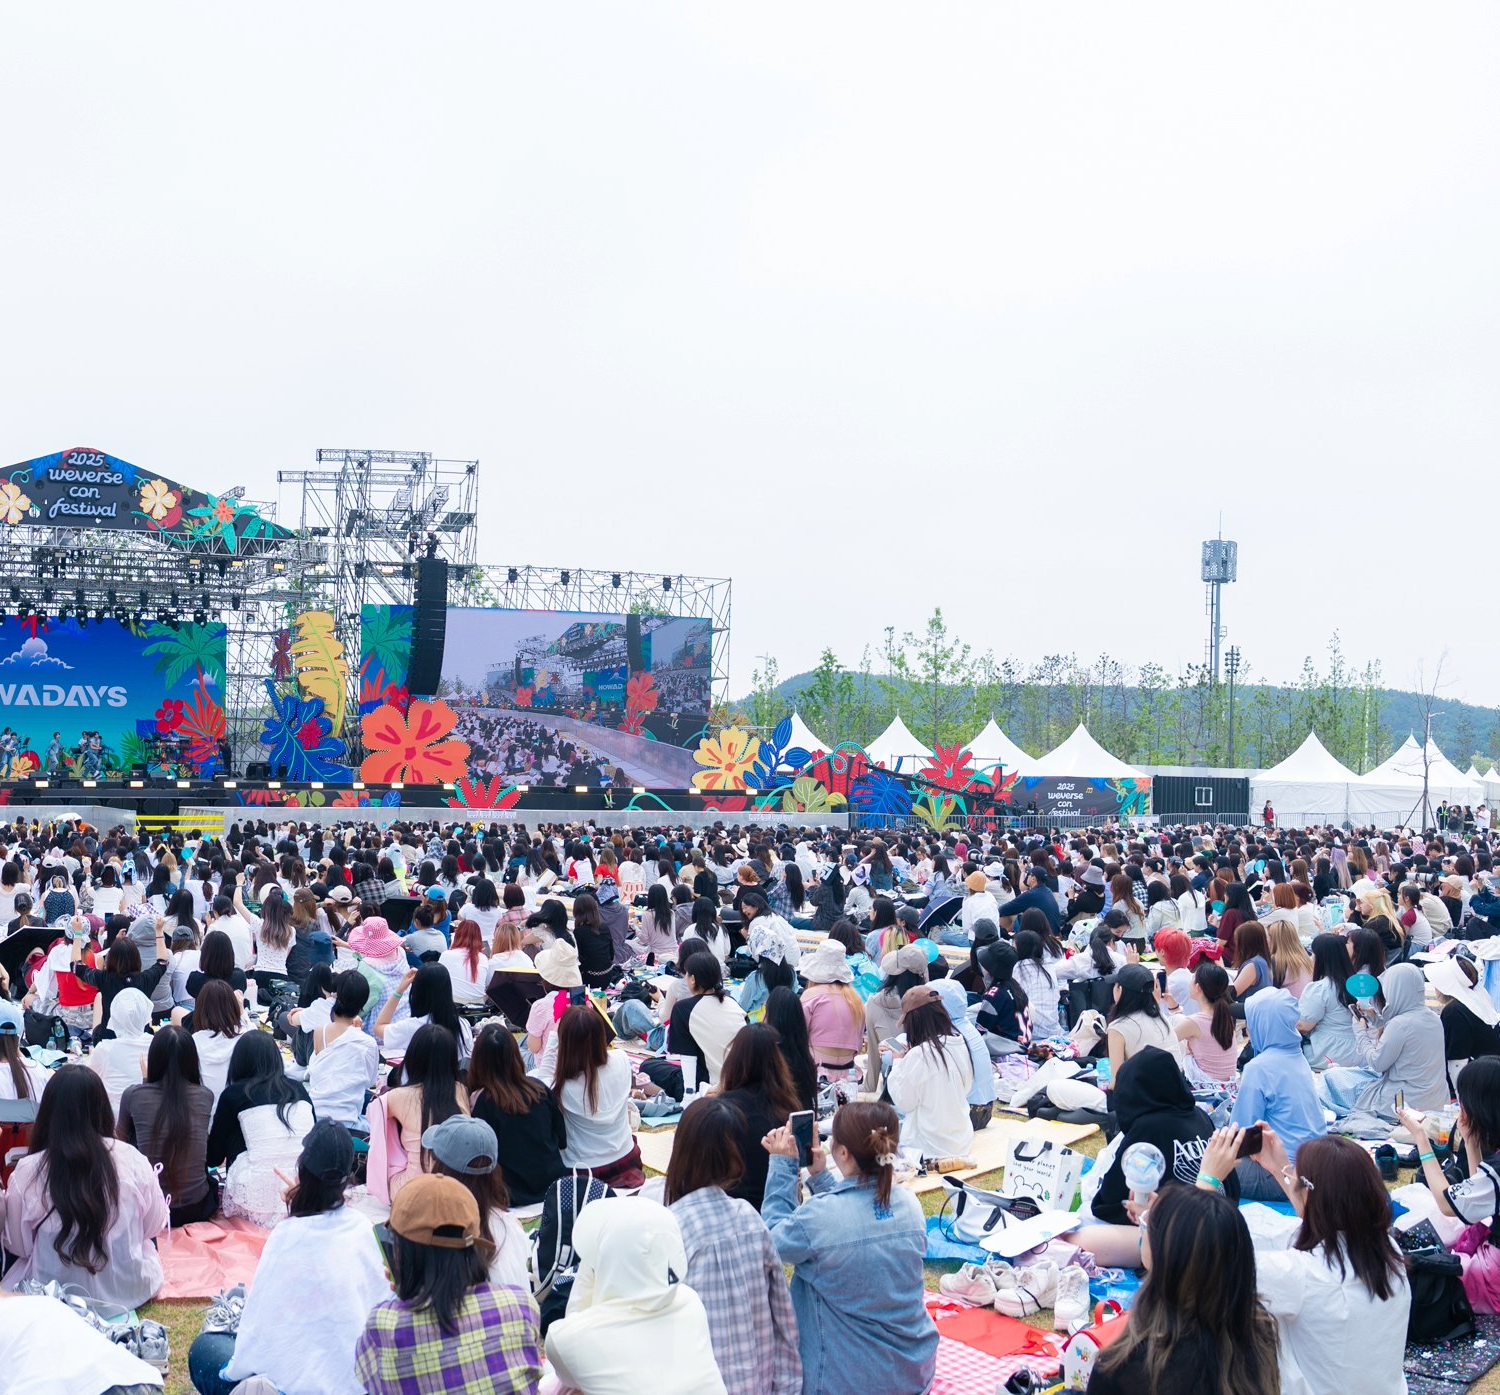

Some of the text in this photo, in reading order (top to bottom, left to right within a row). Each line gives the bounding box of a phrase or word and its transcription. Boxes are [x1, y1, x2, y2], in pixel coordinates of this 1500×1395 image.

[68, 452, 105, 467] 2025
[48, 468, 124, 484] weverse
[69, 486, 101, 498] con
[48, 497, 117, 519] festival
[1056, 782, 1076, 791] 2025
[1047, 792, 1084, 800] weverse
[1057, 800, 1073, 808] con
